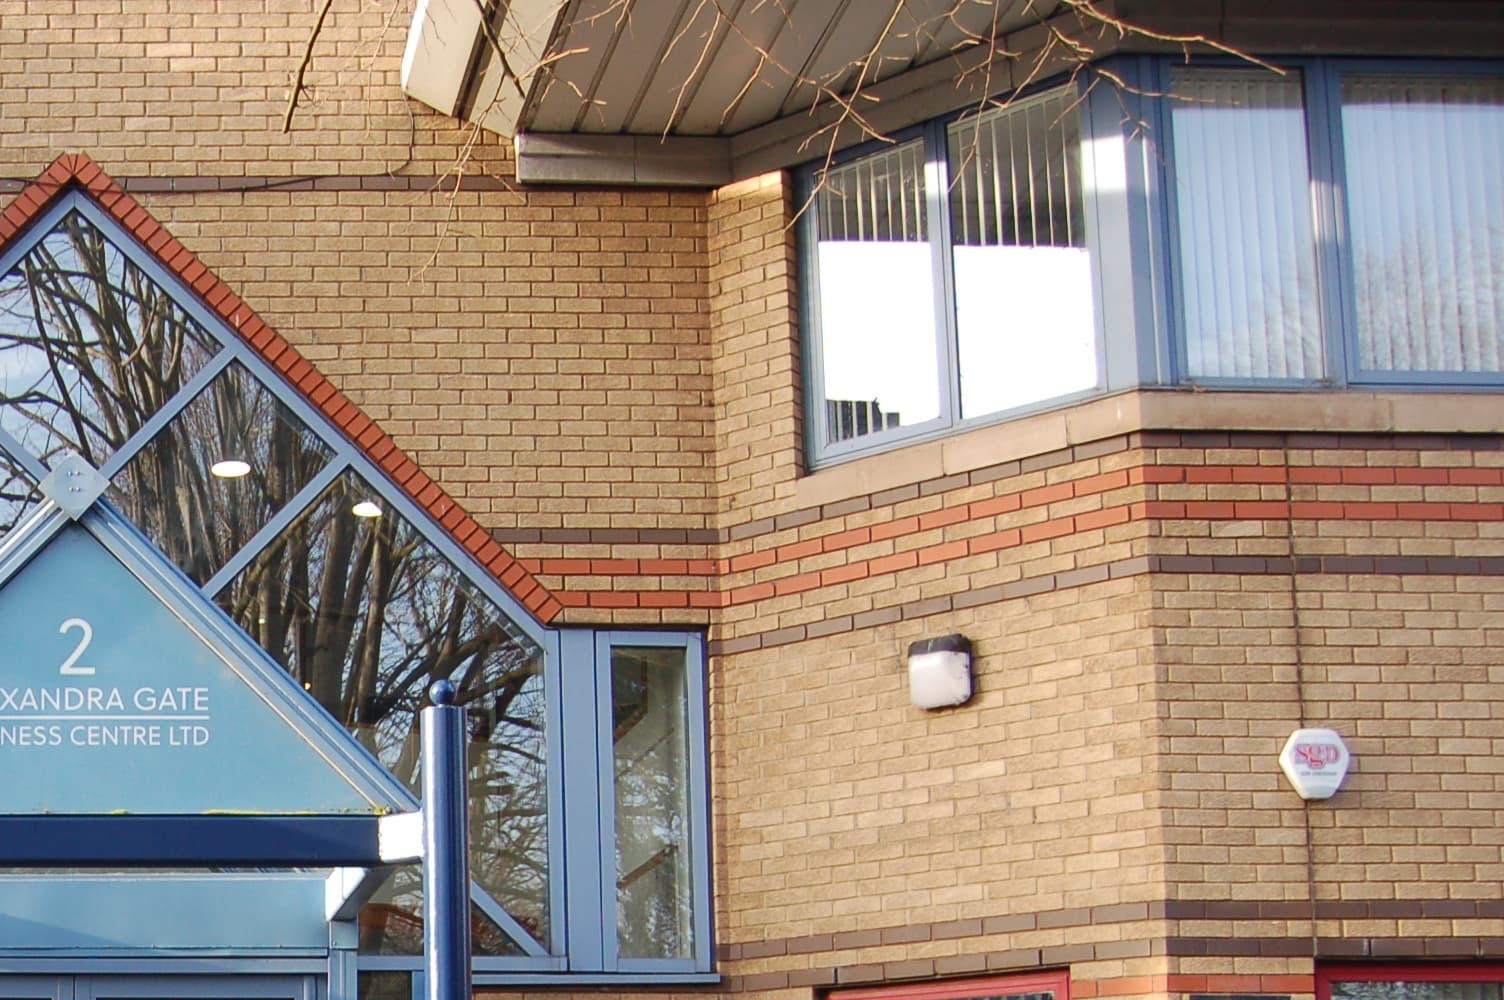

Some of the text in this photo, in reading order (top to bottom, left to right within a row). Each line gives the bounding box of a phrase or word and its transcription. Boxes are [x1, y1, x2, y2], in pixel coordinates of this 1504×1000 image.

[58, 617, 96, 676] 2
[133, 686, 210, 712] GATE
[69, 725, 161, 747] CENTRE
[168, 725, 210, 747] LTD
